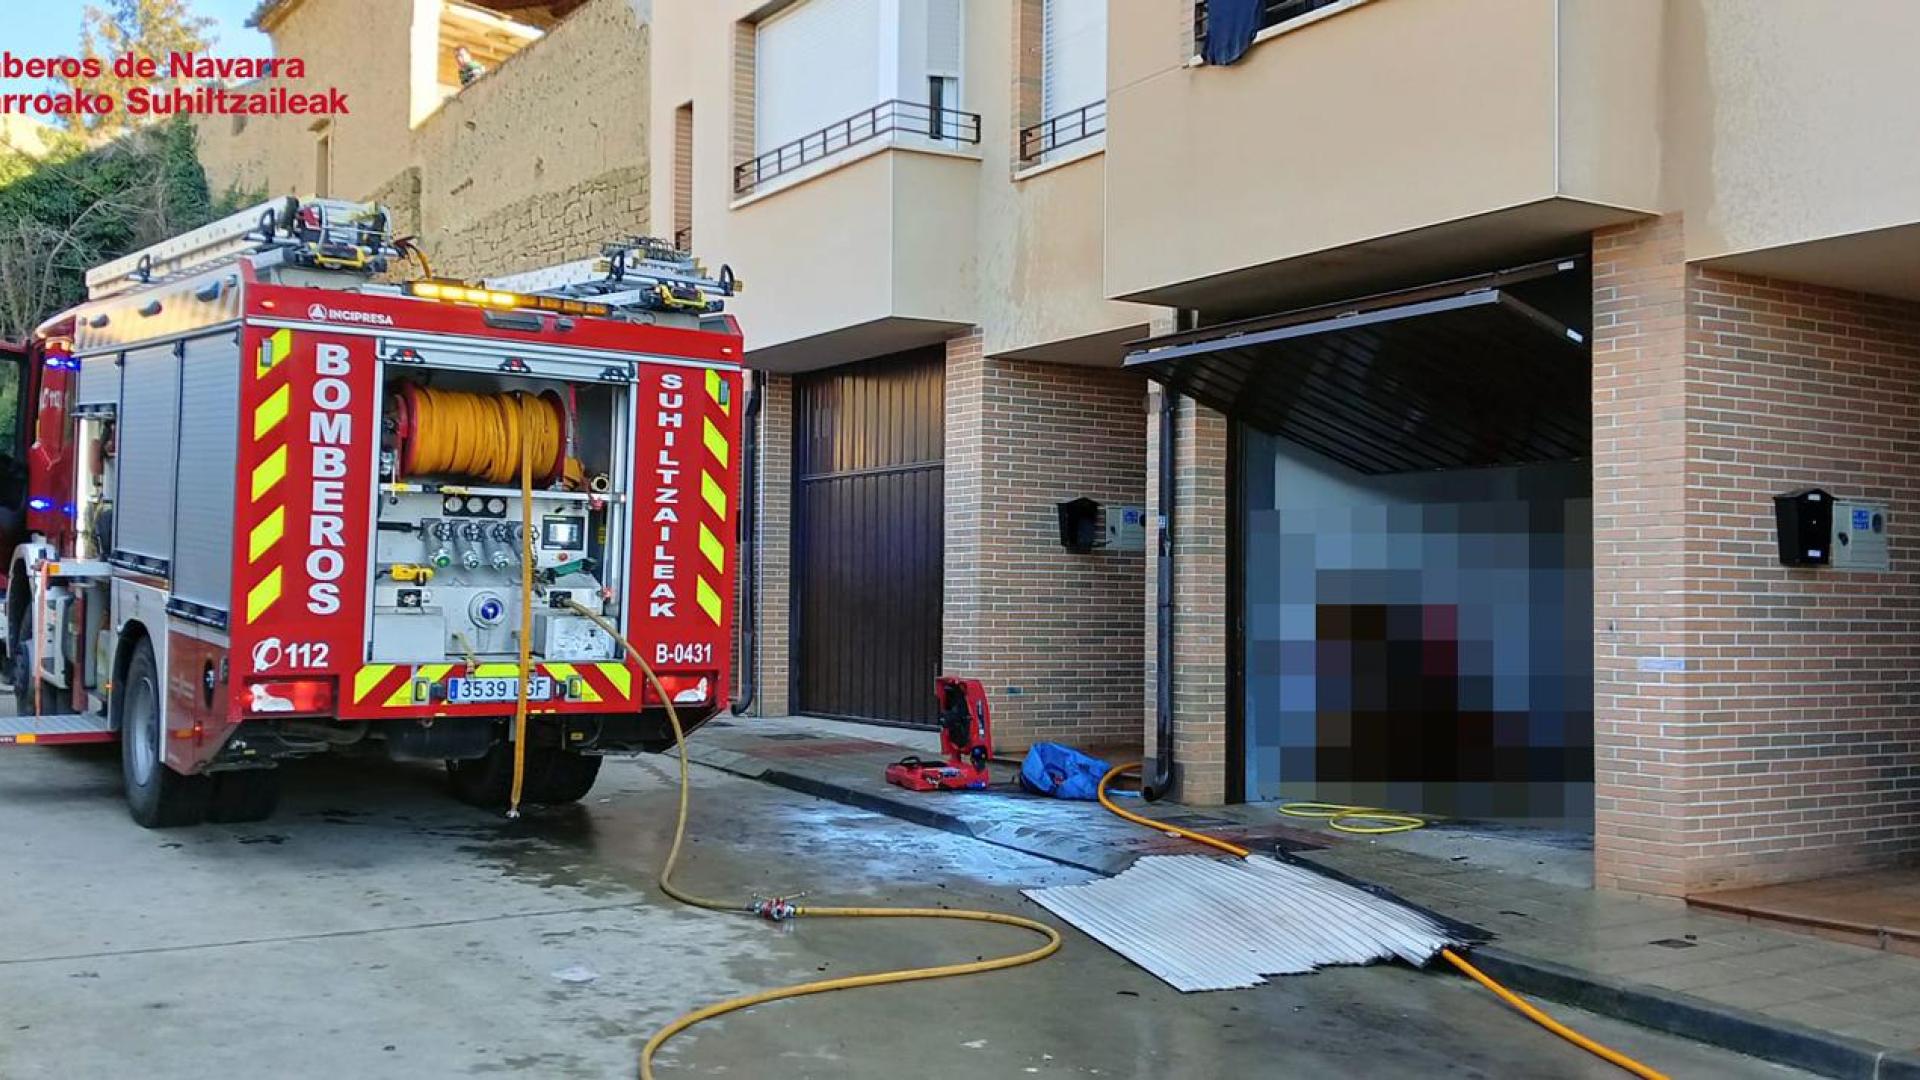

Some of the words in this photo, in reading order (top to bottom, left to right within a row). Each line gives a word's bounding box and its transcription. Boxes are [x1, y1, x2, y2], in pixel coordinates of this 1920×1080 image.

[329, 309, 394, 326] INCIPRESA
[306, 343, 351, 615] BOMBEROS
[650, 374, 683, 617] SUHILTZAILEAK
[284, 643, 329, 668] 112
[656, 643, 711, 664] B-0431
[462, 680, 507, 698] 3539
